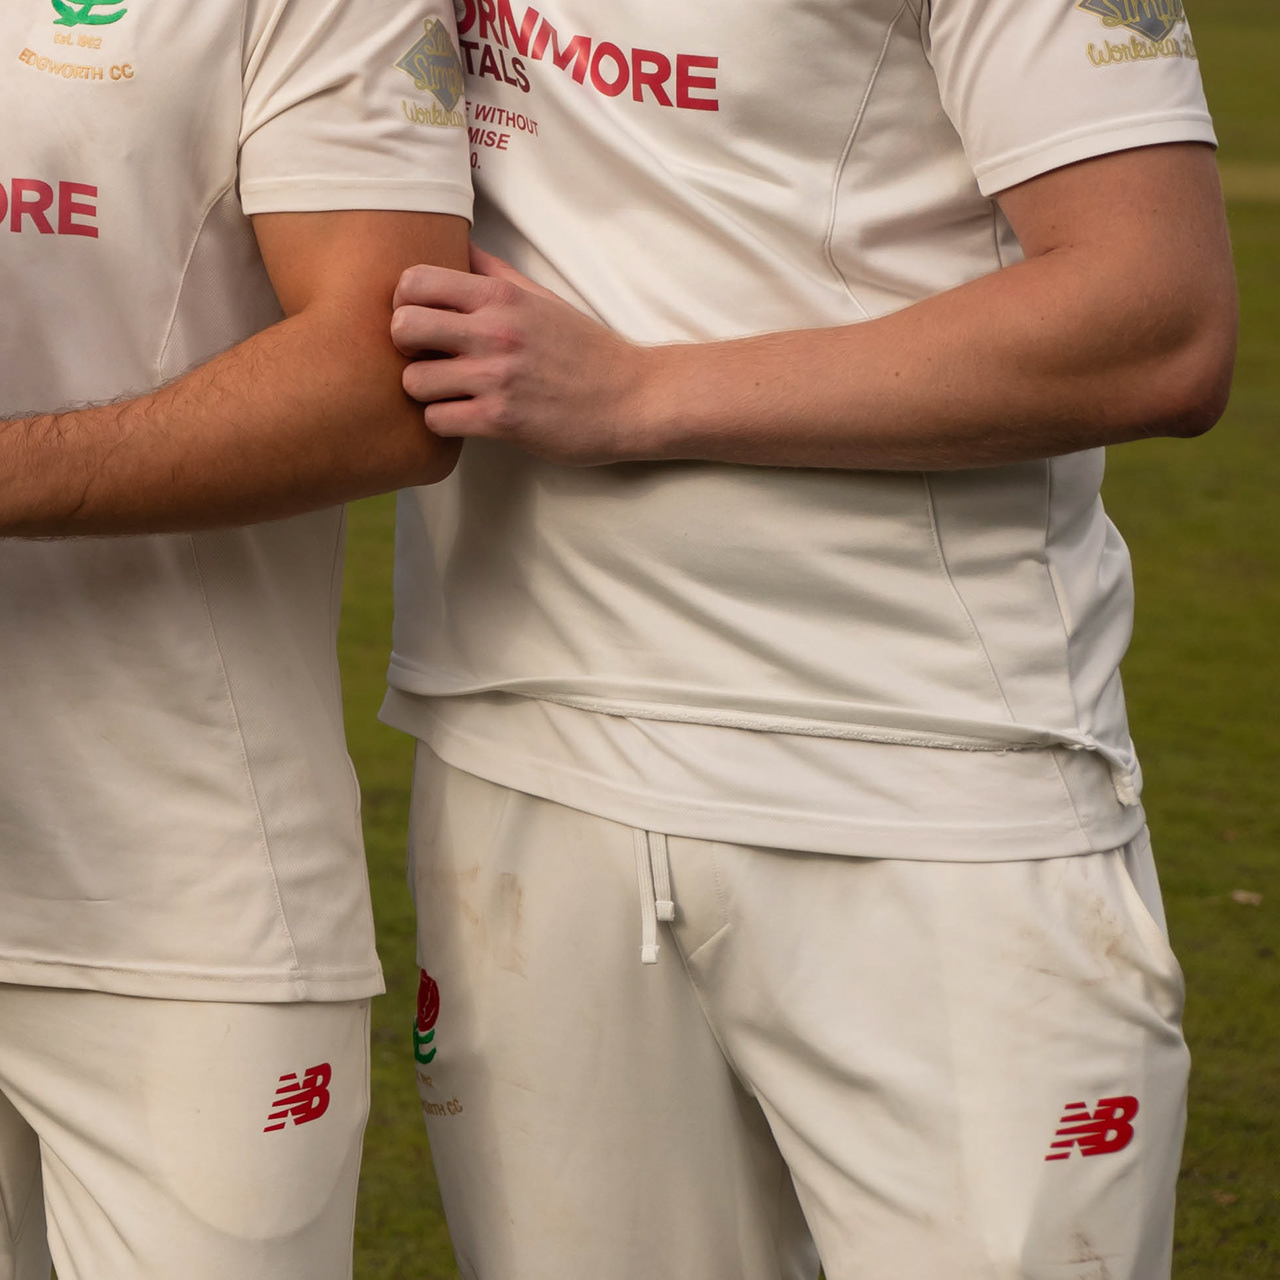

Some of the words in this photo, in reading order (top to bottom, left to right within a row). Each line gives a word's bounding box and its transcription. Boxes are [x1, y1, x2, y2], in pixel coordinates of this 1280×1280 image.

[18, 47, 104, 80] EDGWORTH
[109, 62, 135, 81] CC
[459, 39, 531, 94] TALS
[474, 103, 539, 138] WITHOUT
